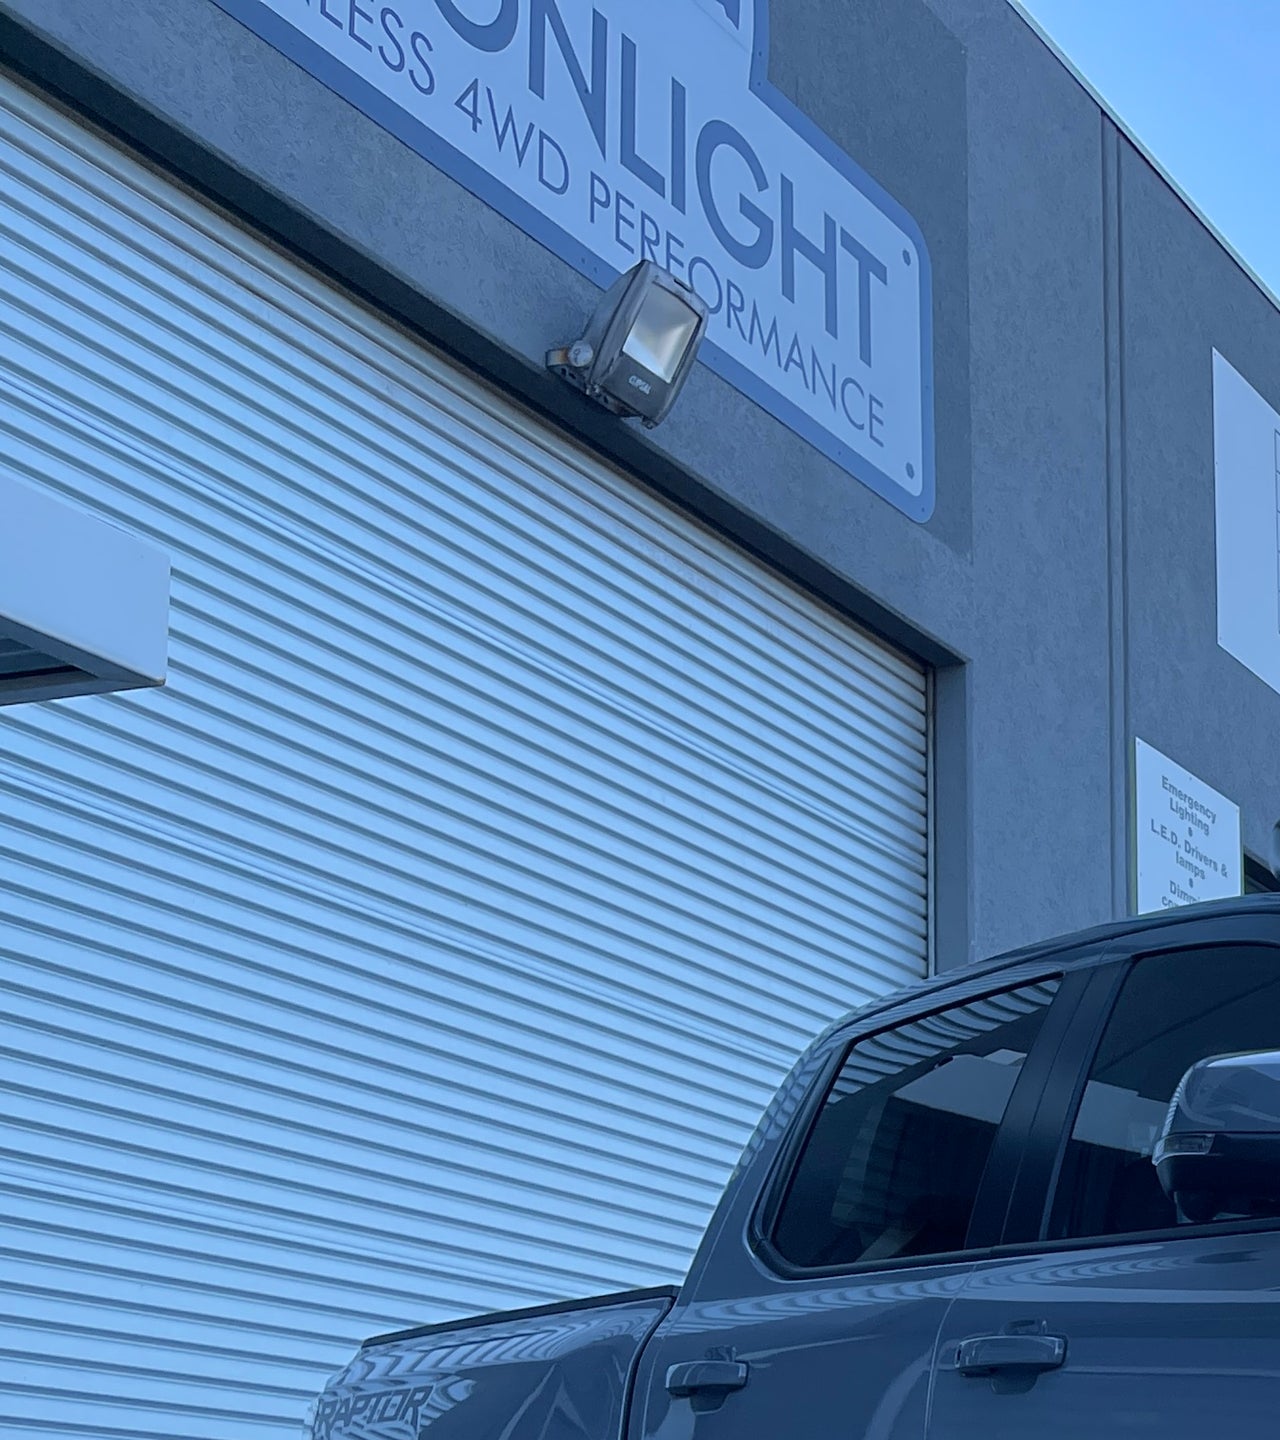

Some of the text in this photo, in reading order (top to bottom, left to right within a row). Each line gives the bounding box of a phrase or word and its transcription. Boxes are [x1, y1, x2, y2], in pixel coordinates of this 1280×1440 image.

[454, 78, 570, 195] 4WD
[590, 171, 885, 448] PERFORMANCE
[1162, 776, 1217, 825] Emergency
[1170, 798, 1210, 837] Lighting
[1151, 818, 1229, 879] L.E.D. Drivers &
[1175, 850, 1206, 880] lamps
